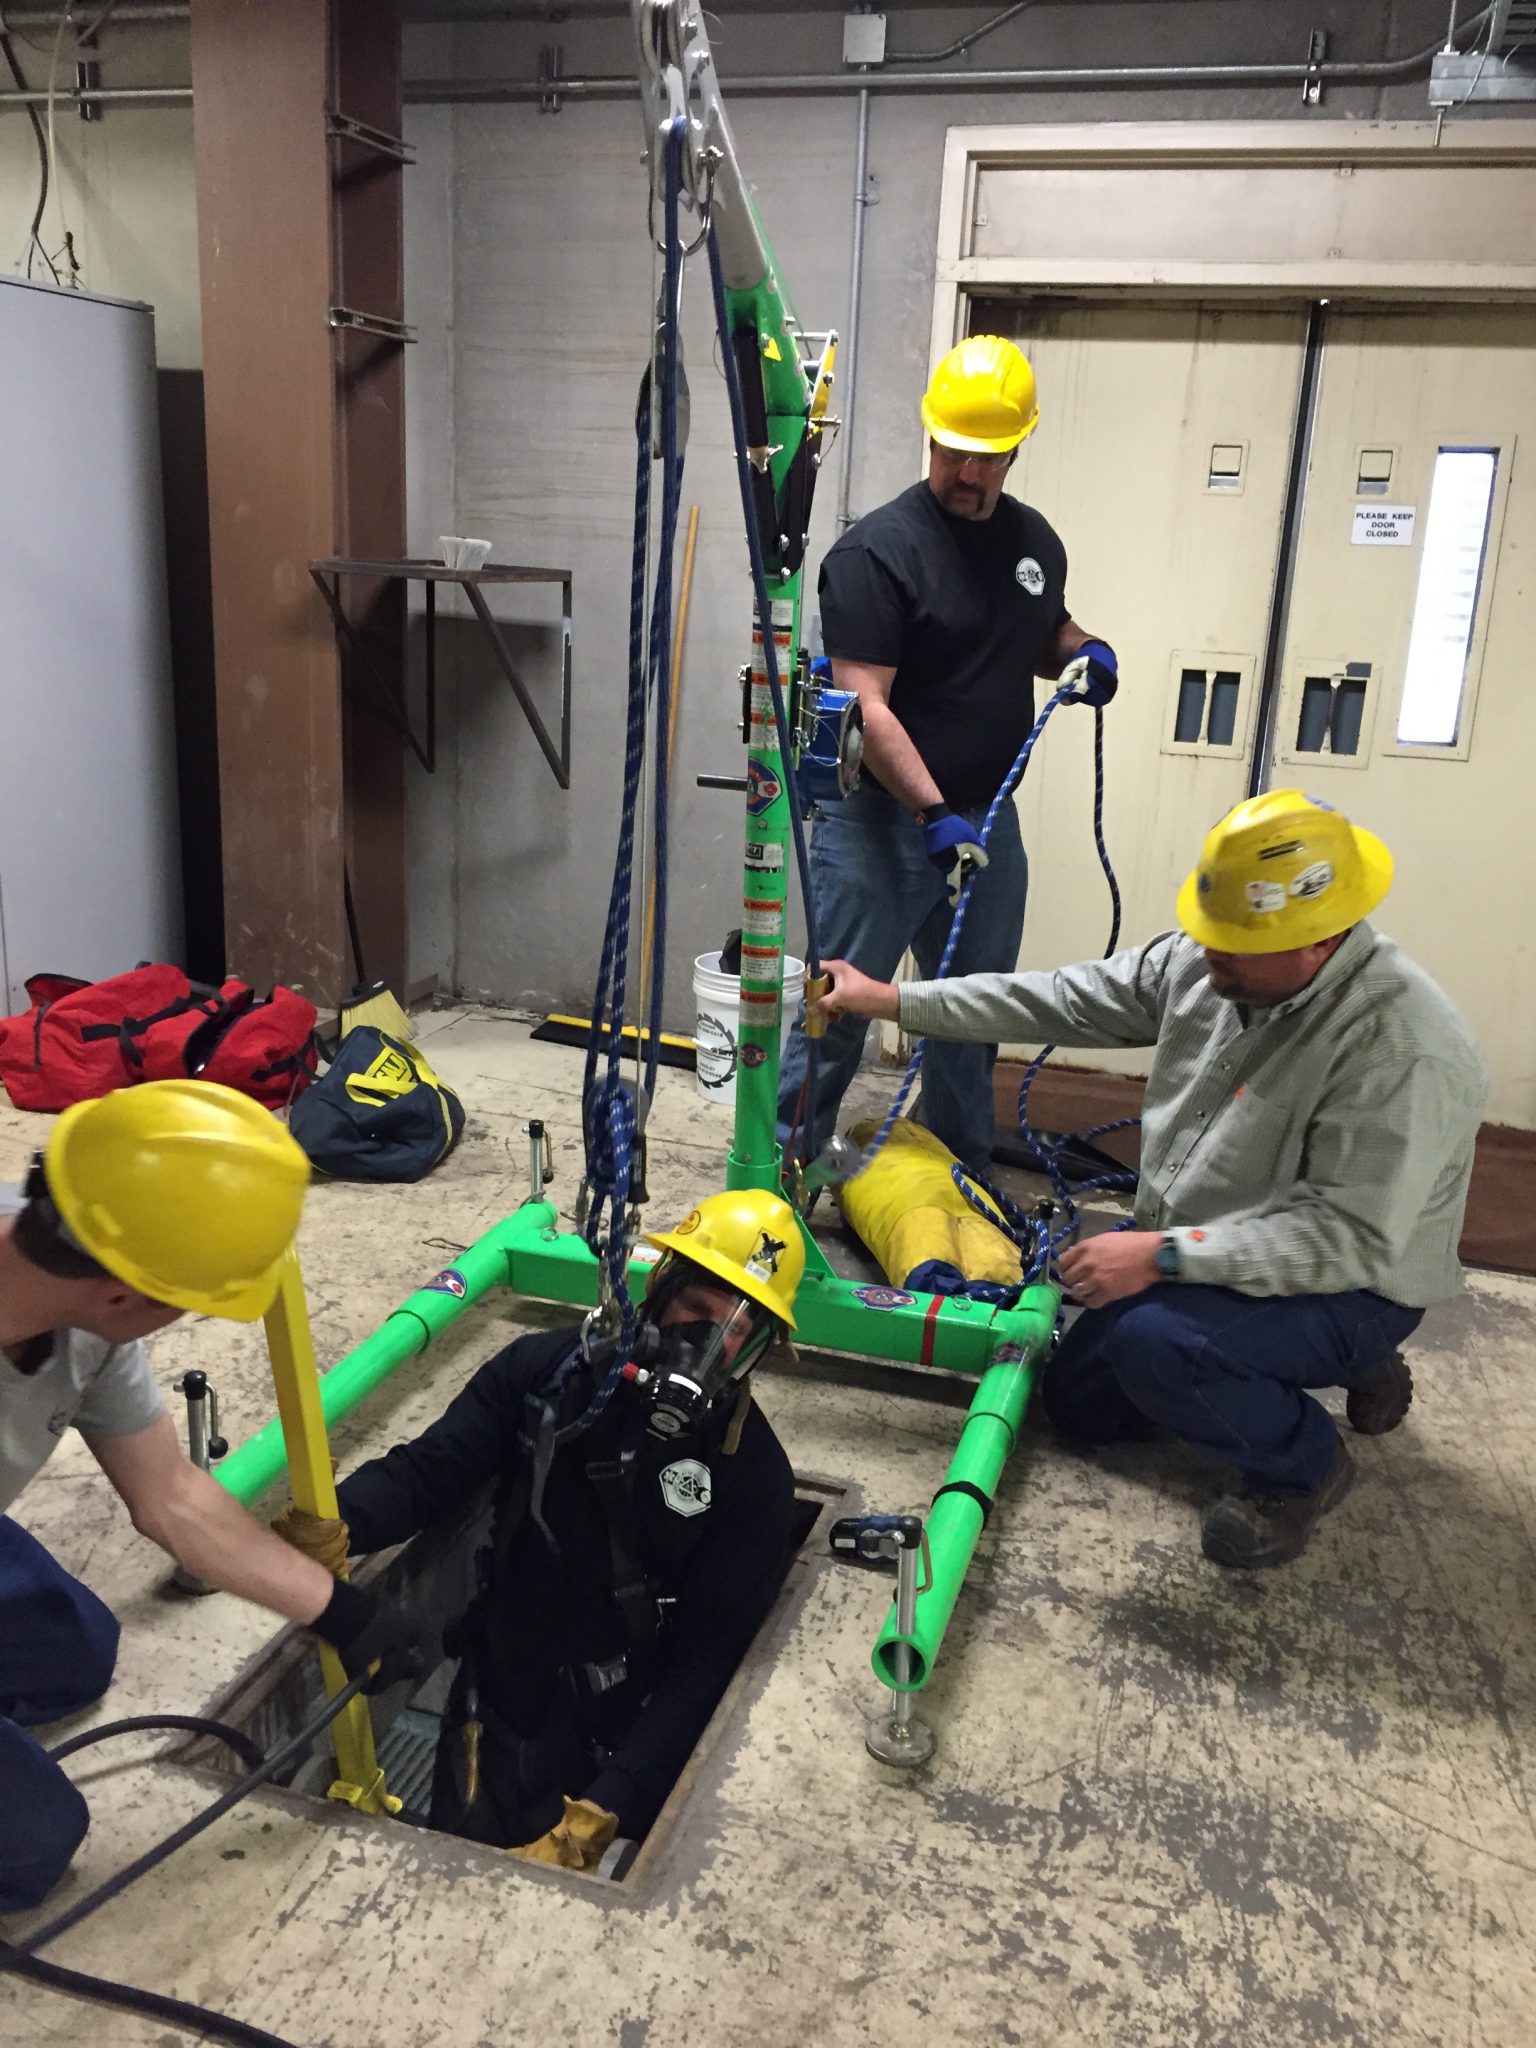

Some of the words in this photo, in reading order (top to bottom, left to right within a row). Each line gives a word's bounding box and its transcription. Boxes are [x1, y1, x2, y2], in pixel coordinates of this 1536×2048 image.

[1355, 512, 1387, 520] PLEASE
[1371, 521, 1396, 529] DOOR
[1365, 530, 1399, 538] CLOSED
